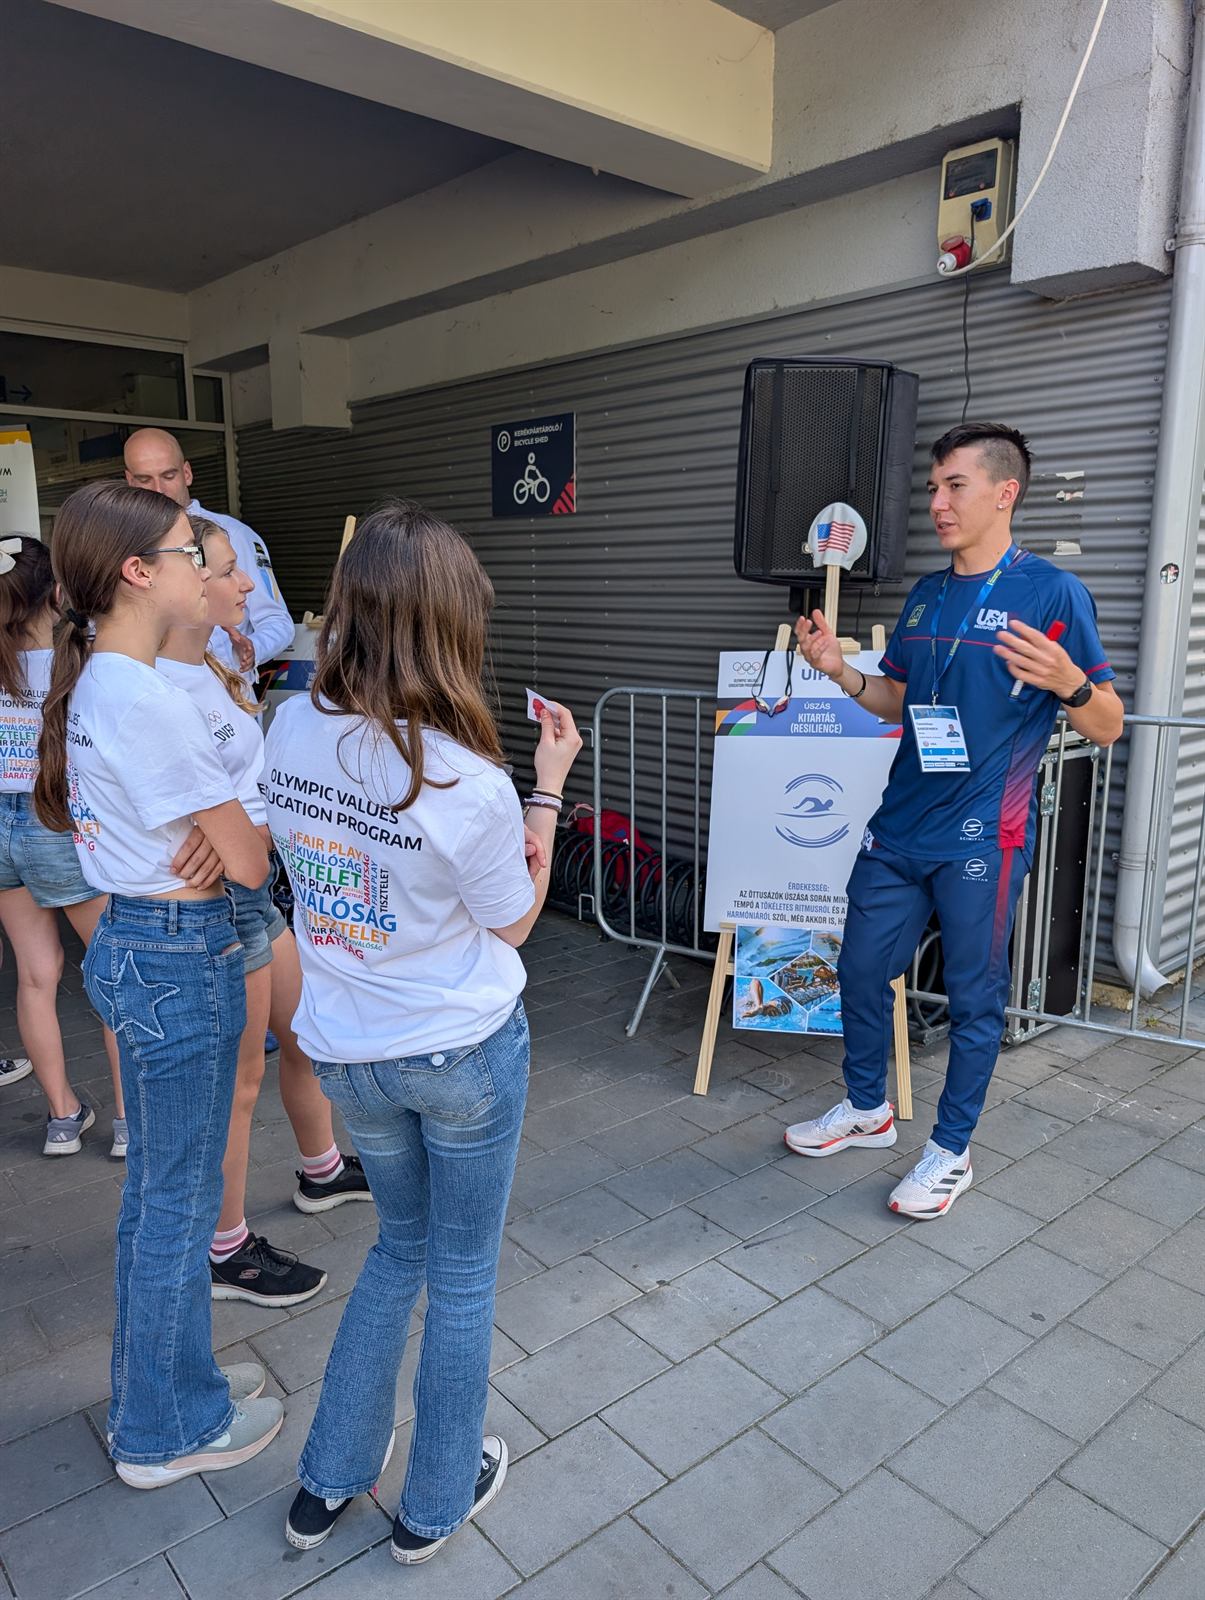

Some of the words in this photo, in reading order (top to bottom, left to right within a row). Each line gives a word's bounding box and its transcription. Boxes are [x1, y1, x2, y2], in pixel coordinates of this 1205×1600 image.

[500, 435, 508, 448] P
[514, 438, 534, 446] BICYCLE
[534, 436, 548, 444] SHED
[976, 608, 1008, 630] USA
[801, 668, 832, 681] UIP
[21, 689, 49, 699] VALUE
[803, 701, 831, 710] ÚSZÁS
[798, 712, 836, 723] KITARTÁS
[790, 722, 843, 734] (RESILIENCE)
[0, 731, 38, 741] ZTELET
[271, 768, 334, 802] OLYMPIC
[337, 790, 399, 825] VALUES
[257, 783, 333, 823] EDUCATION
[336, 812, 423, 851] PROGRAM
[296, 831, 325, 851] FAIR
[328, 841, 363, 860] PLAY
[280, 846, 362, 888] TISZTELET
[296, 845, 362, 874] KIVÁLÓSÁG
[362, 854, 371, 906] BARÁTSÁG
[788, 882, 830, 892] ÉRDEKESSÉG:
[309, 879, 342, 897] PLAY
[379, 868, 389, 913] TISZTELET
[739, 890, 747, 898] AZ
[785, 891, 809, 901] ÚSZÁSA
[810, 894, 831, 903] SORÁN
[833, 895, 850, 904] MIND
[733, 900, 754, 909] TEMPÓ
[755, 901, 760, 909] A
[832, 905, 840, 914] ÉS
[841, 907, 846, 915] A
[727, 911, 771, 920] HARMÓNIÁRÓL
[772, 912, 790, 923] SZÓL,
[791, 914, 804, 923] MÉG
[805, 915, 827, 924] AKKOR
[307, 910, 390, 945] TISZTELET
[310, 934, 365, 960] RÁTSÁG
